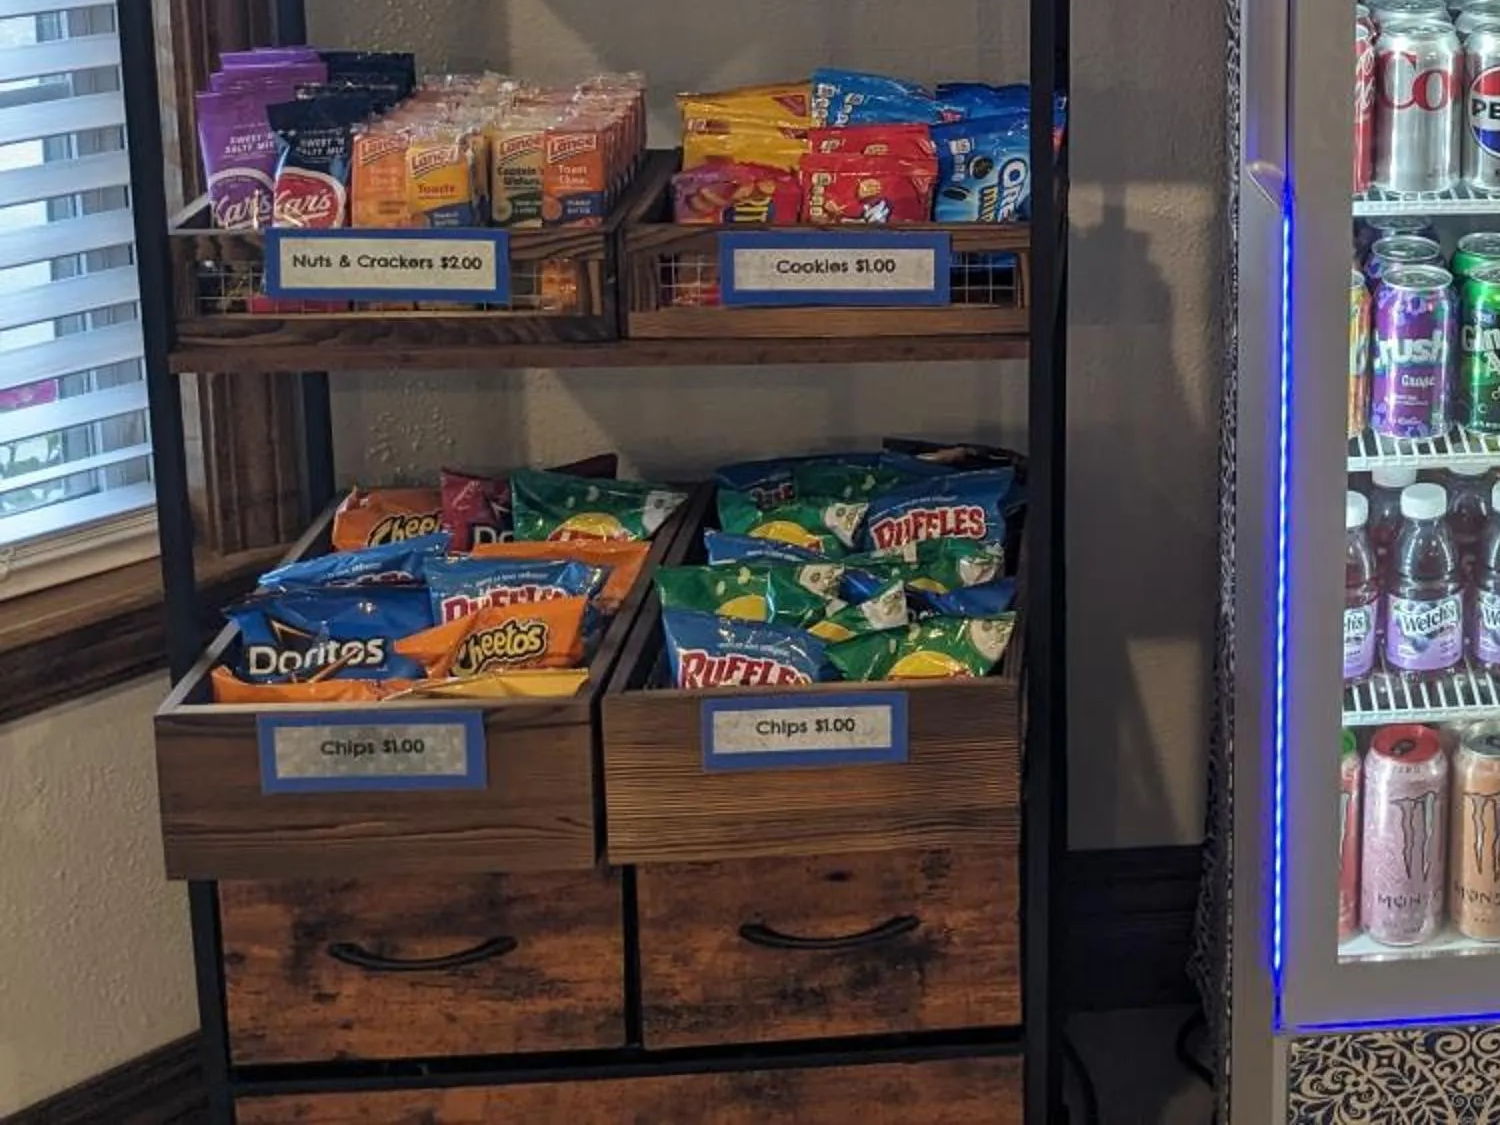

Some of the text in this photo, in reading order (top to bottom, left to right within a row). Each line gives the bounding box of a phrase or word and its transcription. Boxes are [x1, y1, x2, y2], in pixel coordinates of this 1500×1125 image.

[293, 255, 482, 270] Nuts & Crackers $2.00
[776, 258, 895, 275] Cookies $1.00
[872, 505, 986, 550] RUFFLES
[1402, 601, 1460, 632] Welch's
[249, 638, 384, 676] Doritos
[453, 620, 549, 676] Cheetos
[756, 717, 855, 736] Chips $1.00
[321, 738, 425, 758] Chips $1.00
